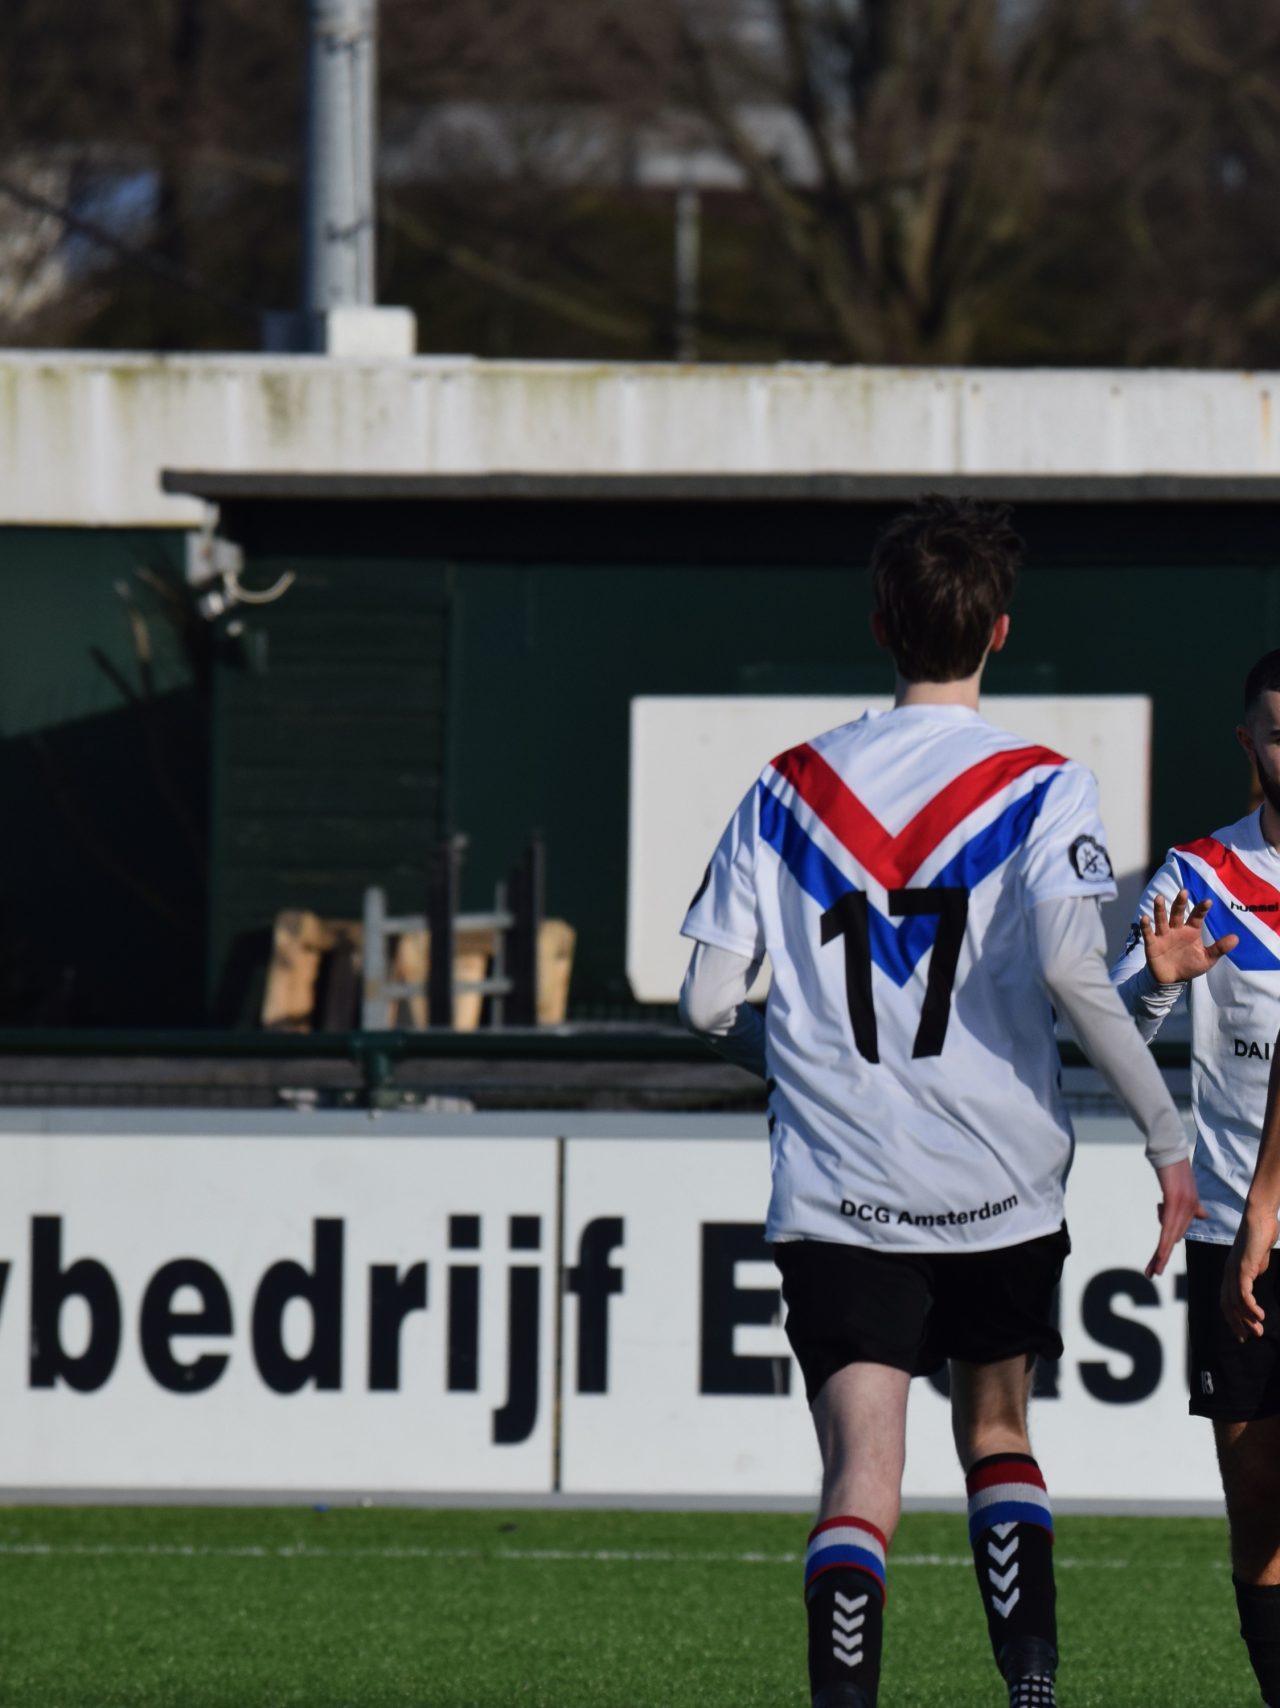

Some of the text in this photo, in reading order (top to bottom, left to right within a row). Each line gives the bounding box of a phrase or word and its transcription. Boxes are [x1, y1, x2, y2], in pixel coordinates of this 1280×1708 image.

[1230, 901, 1279, 912] hummel
[820, 888, 969, 1064] 17
[1234, 1039, 1278, 1060] DAI
[840, 1194, 1018, 1227] DCG Amsterdam
[0, 1215, 625, 1445] bedrijf
